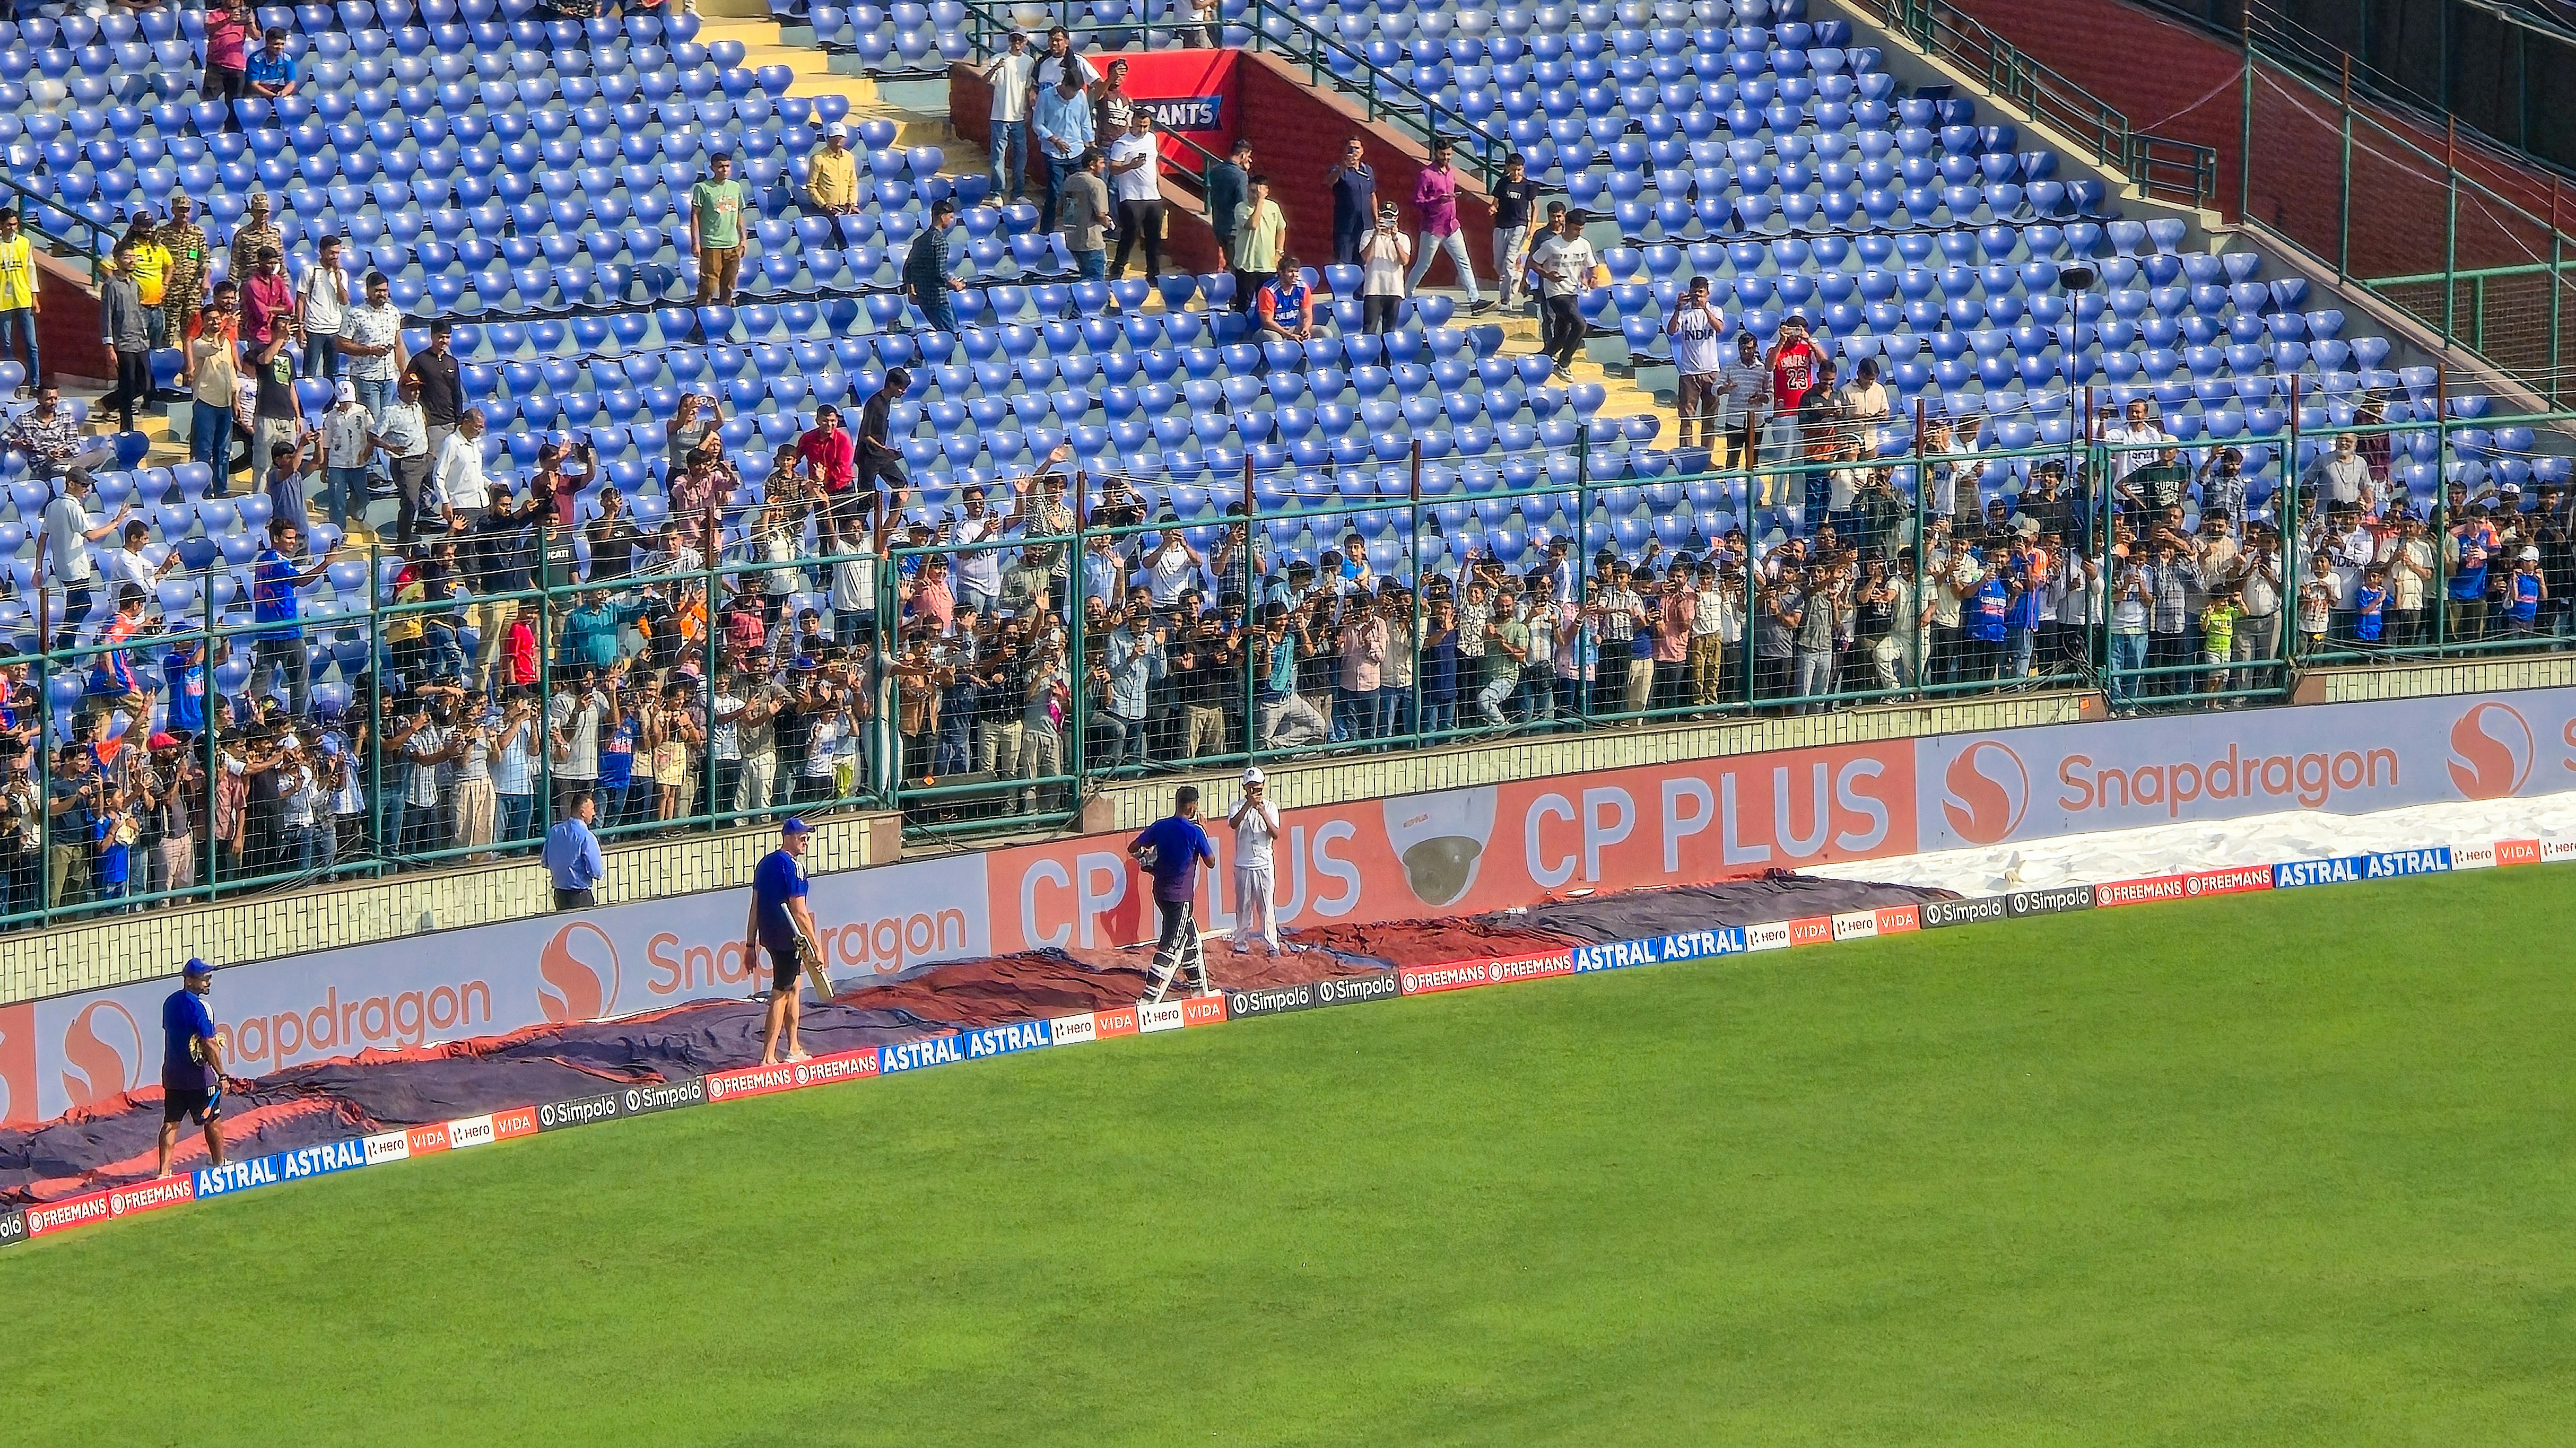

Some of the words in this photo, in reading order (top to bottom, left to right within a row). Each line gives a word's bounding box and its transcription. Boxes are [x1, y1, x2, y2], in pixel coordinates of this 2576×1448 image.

[1787, 368, 1808, 390] 23
[2058, 743, 2398, 818] Snapdragon
[1525, 786, 1637, 888] CP
[1661, 757, 1890, 874] PLUS
[2368, 850, 2448, 878] ASTRAL
[2501, 844, 2534, 859] VIDA
[1020, 851, 1127, 951] CP
[1153, 819, 1362, 938] LUS
[2202, 869, 2270, 890] FREEMANS
[2279, 859, 2359, 887] ASTRAL
[2114, 880, 2182, 901] FREEMANS
[1795, 924, 1827, 938] VIDA
[1881, 913, 1914, 928] VIDA
[647, 907, 966, 995] Snapragon
[1577, 941, 1656, 972] ASTRAL
[1663, 929, 1743, 959] ASTRAL
[1418, 965, 1485, 987] FREEMANS
[1504, 955, 1571, 978] FREEMANS
[215, 980, 491, 1070] napdragon
[1100, 1015, 1133, 1031] VIDA
[1187, 1004, 1220, 1018] VIDA
[970, 1023, 1048, 1057] ASTRAL
[810, 1055, 876, 1080] FREEMANS
[884, 1038, 962, 1072] ASTRAL
[725, 1068, 791, 1094] FREEMANS
[498, 1115, 530, 1133] VIDA
[412, 1131, 446, 1148] VIDA
[285, 1142, 363, 1178] ASTRAL
[199, 1159, 277, 1196] ASTRAL
[125, 1179, 192, 1209] FREEMANS
[43, 1198, 107, 1228] FREEMANS
